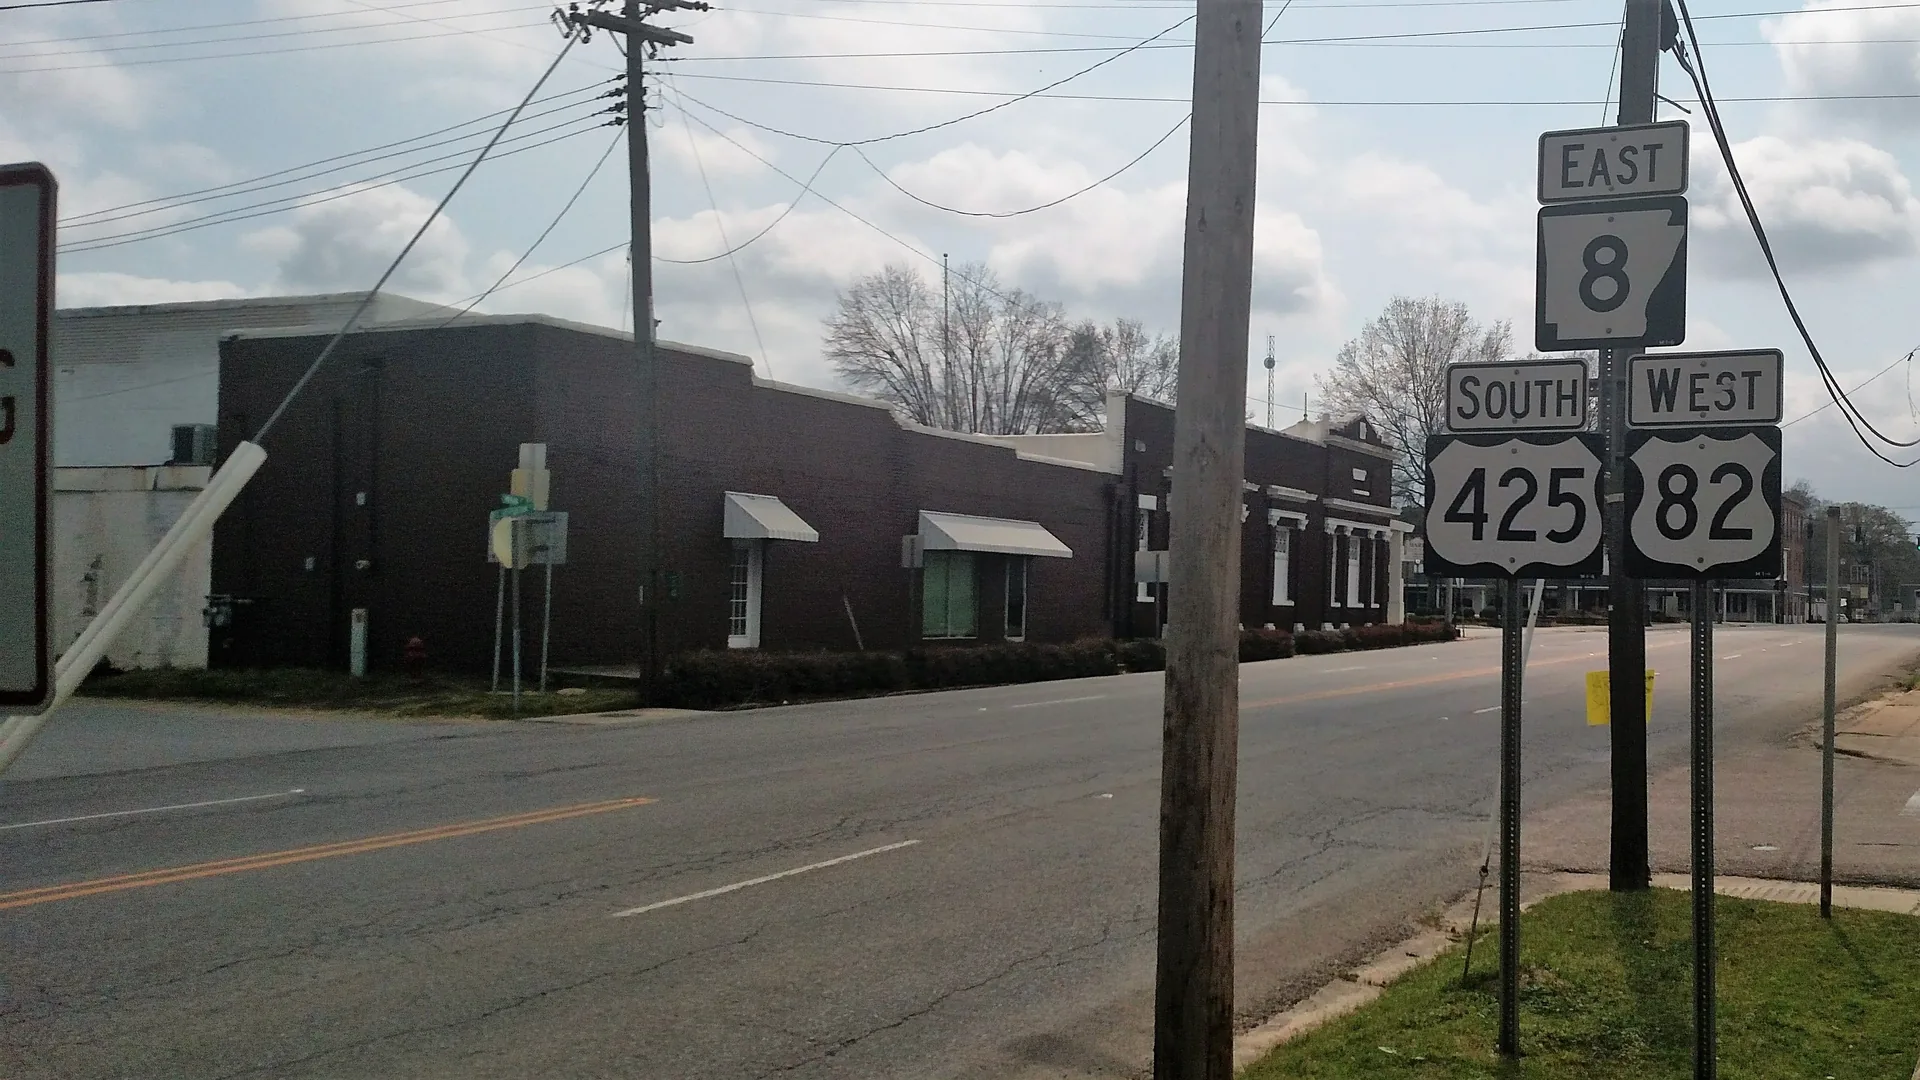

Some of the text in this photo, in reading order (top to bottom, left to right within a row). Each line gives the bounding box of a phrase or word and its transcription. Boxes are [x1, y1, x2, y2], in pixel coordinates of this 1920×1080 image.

[1561, 144, 1663, 188] EAST
[1579, 235, 1630, 312] 8
[1457, 375, 1578, 419] SOUTH
[1647, 368, 1762, 412] WEST
[1444, 468, 1586, 544] 425
[1656, 462, 1754, 540] 82
